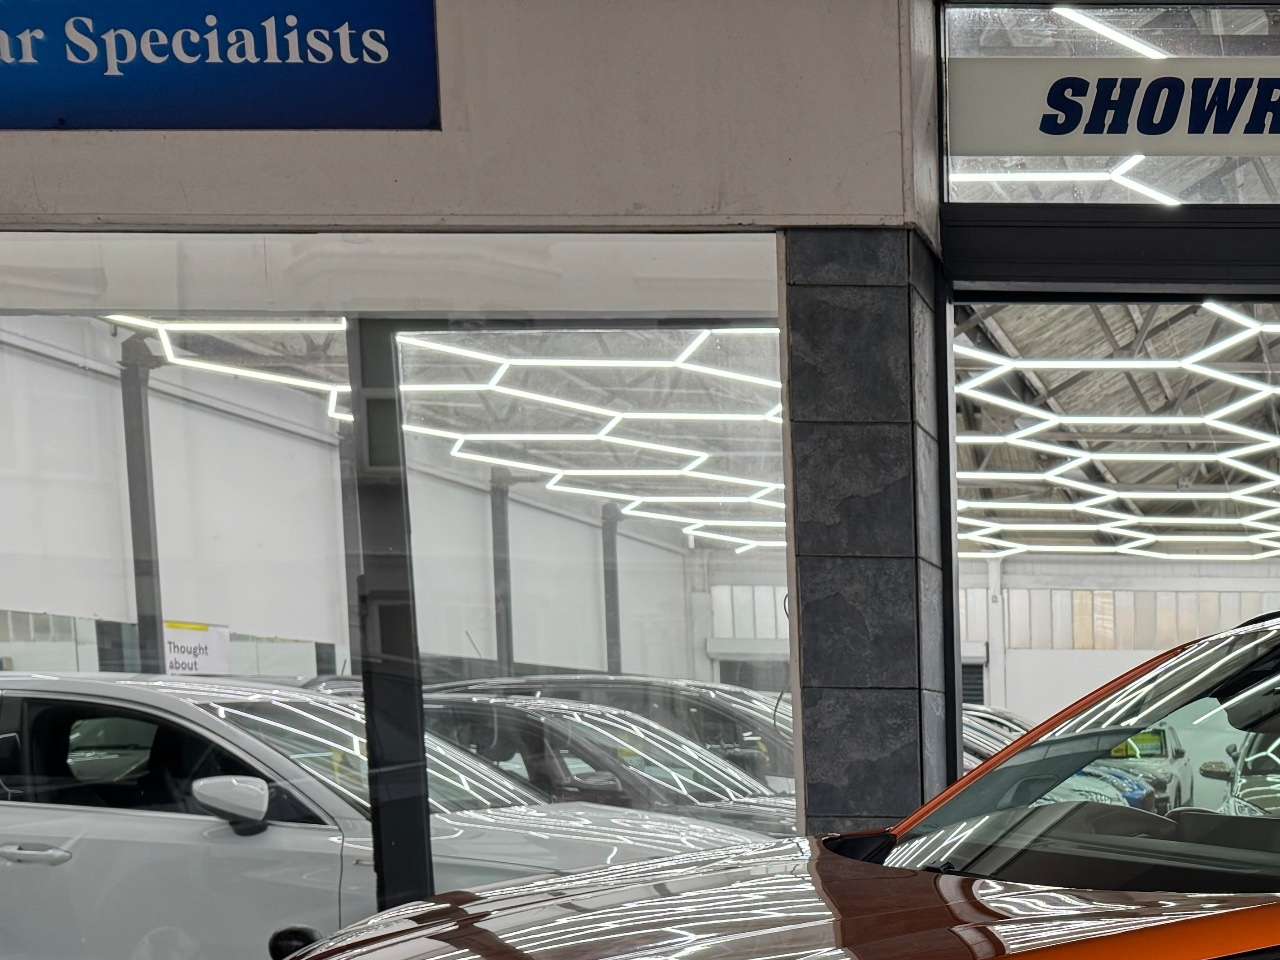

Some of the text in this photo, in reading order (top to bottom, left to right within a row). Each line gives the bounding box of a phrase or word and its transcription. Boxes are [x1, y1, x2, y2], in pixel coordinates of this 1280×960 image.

[64, 15, 390, 76] Specialists
[167, 641, 209, 657] Thought
[169, 657, 199, 671] about
